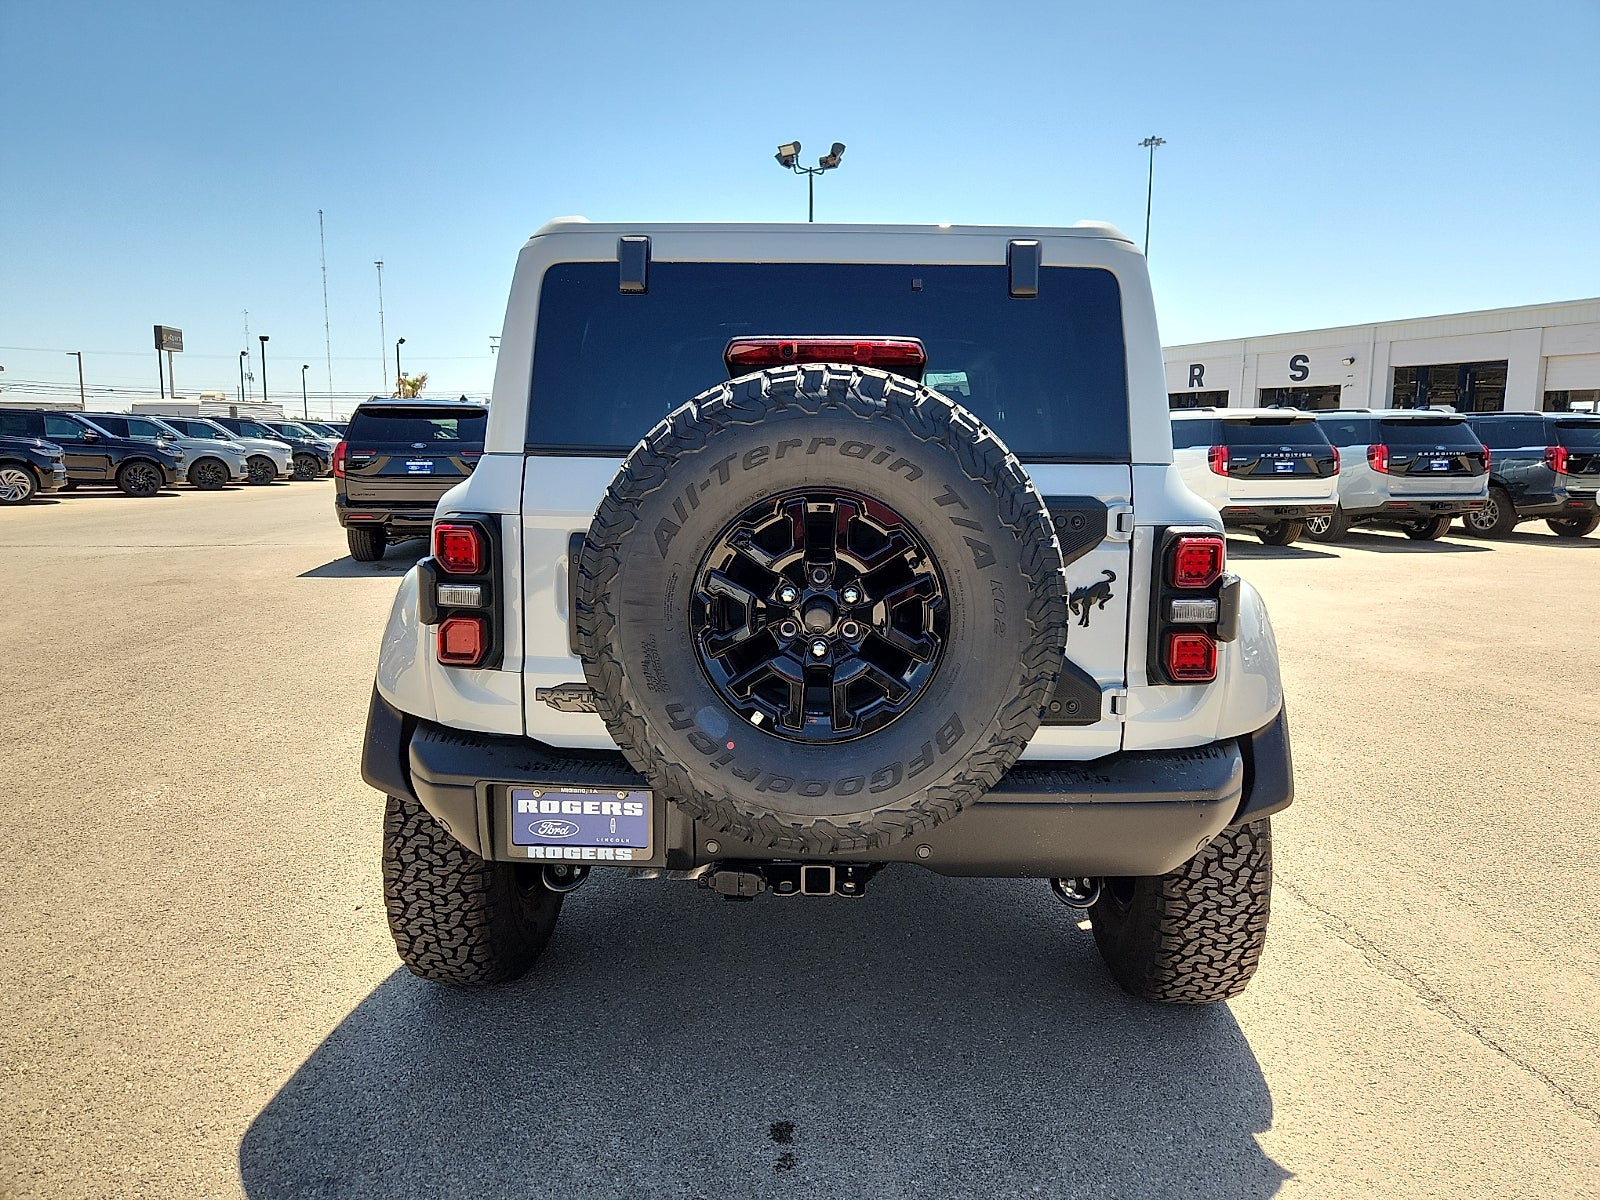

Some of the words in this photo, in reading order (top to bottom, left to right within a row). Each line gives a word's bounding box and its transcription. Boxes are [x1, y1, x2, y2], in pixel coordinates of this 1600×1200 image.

[1188, 363, 1205, 388] R
[1289, 354, 1310, 382] S
[653, 435, 927, 560] All-Terrain
[932, 485, 997, 570] T/A
[664, 703, 966, 798] BFGoodrich
[517, 799, 644, 816] ROGERS
[537, 821, 570, 836] Ford
[527, 846, 633, 861] ROGERS
